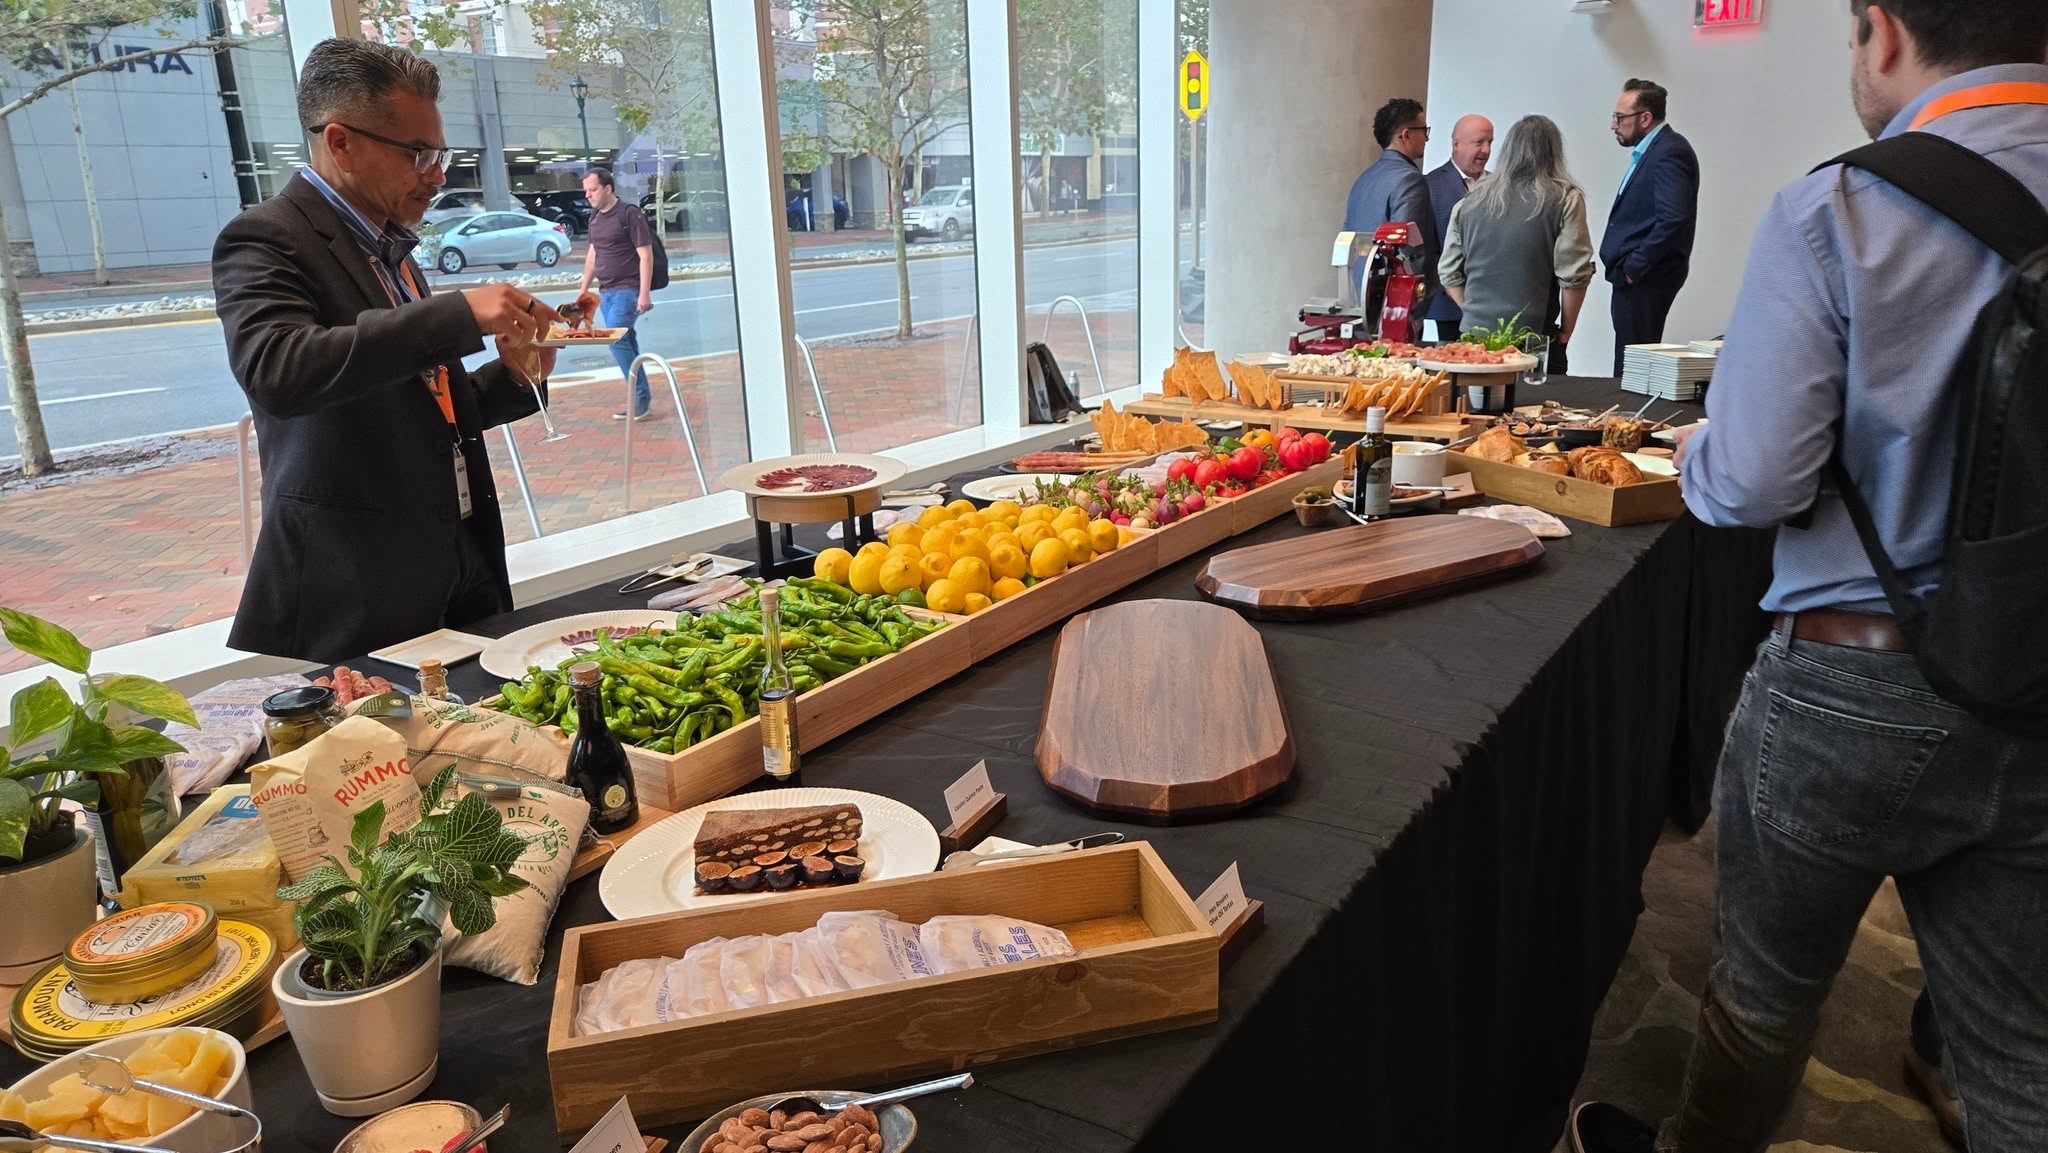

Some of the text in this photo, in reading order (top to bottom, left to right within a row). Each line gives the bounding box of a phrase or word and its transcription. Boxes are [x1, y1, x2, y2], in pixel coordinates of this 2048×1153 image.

[252, 782, 308, 809] RUMMO
[507, 806, 570, 850] DEL ARROZ
[1208, 915, 1219, 927] Olive
[1222, 900, 1234, 912] Tortas
[1215, 892, 1229, 907] Rosales
[902, 936, 930, 976] INES
[32, 972, 80, 1032] PARAMOUNT
[169, 997, 206, 1015] LONG
[206, 975, 242, 999] ISLAND
